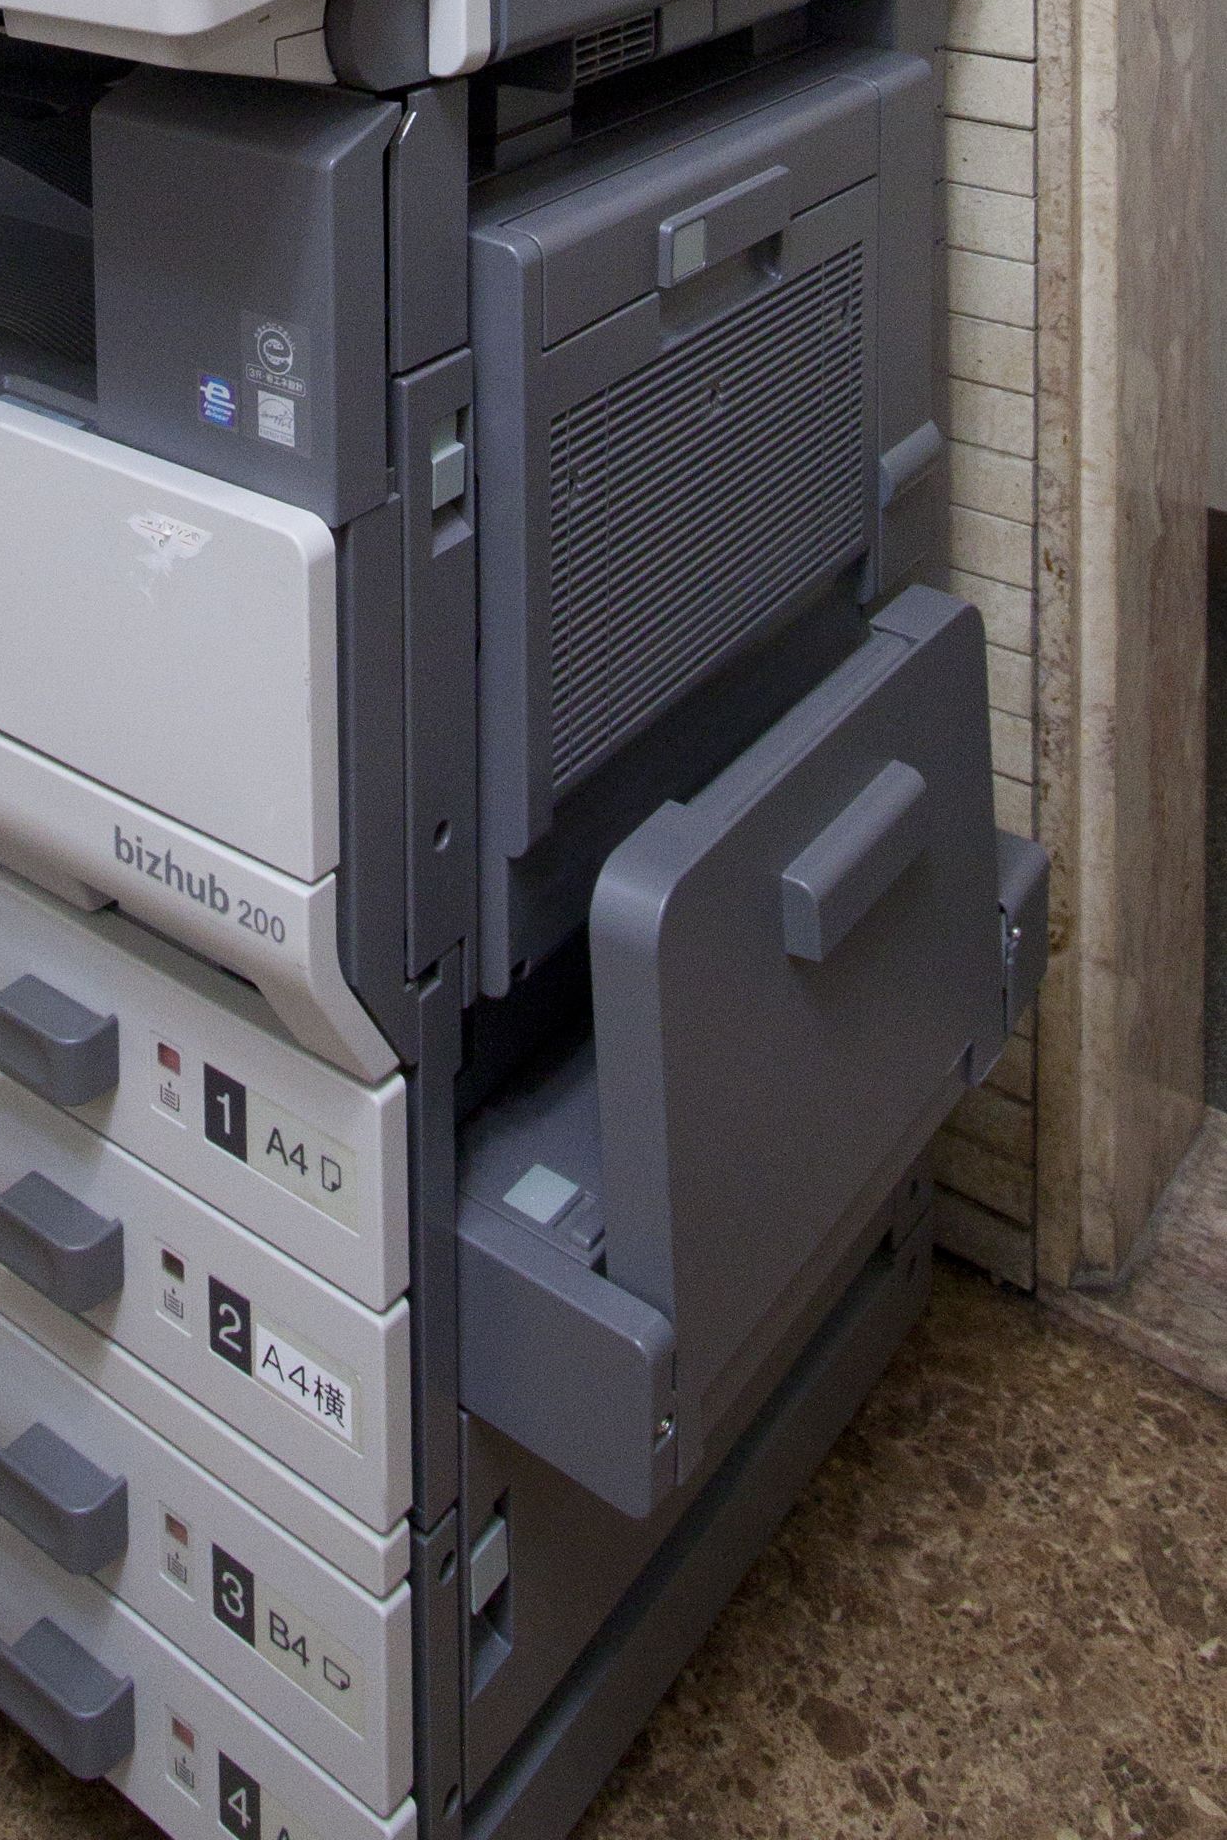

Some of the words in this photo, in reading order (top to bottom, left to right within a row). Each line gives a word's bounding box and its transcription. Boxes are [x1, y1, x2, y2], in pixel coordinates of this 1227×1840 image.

[114, 825, 230, 915] bizhub
[237, 899, 285, 943] 200
[216, 1092, 231, 1136] 1
[266, 1126, 309, 1176] A4
[218, 1303, 243, 1353] 2
[222, 1571, 245, 1618] 3
[269, 1609, 310, 1668] B4
[227, 1786, 252, 1829] 4
